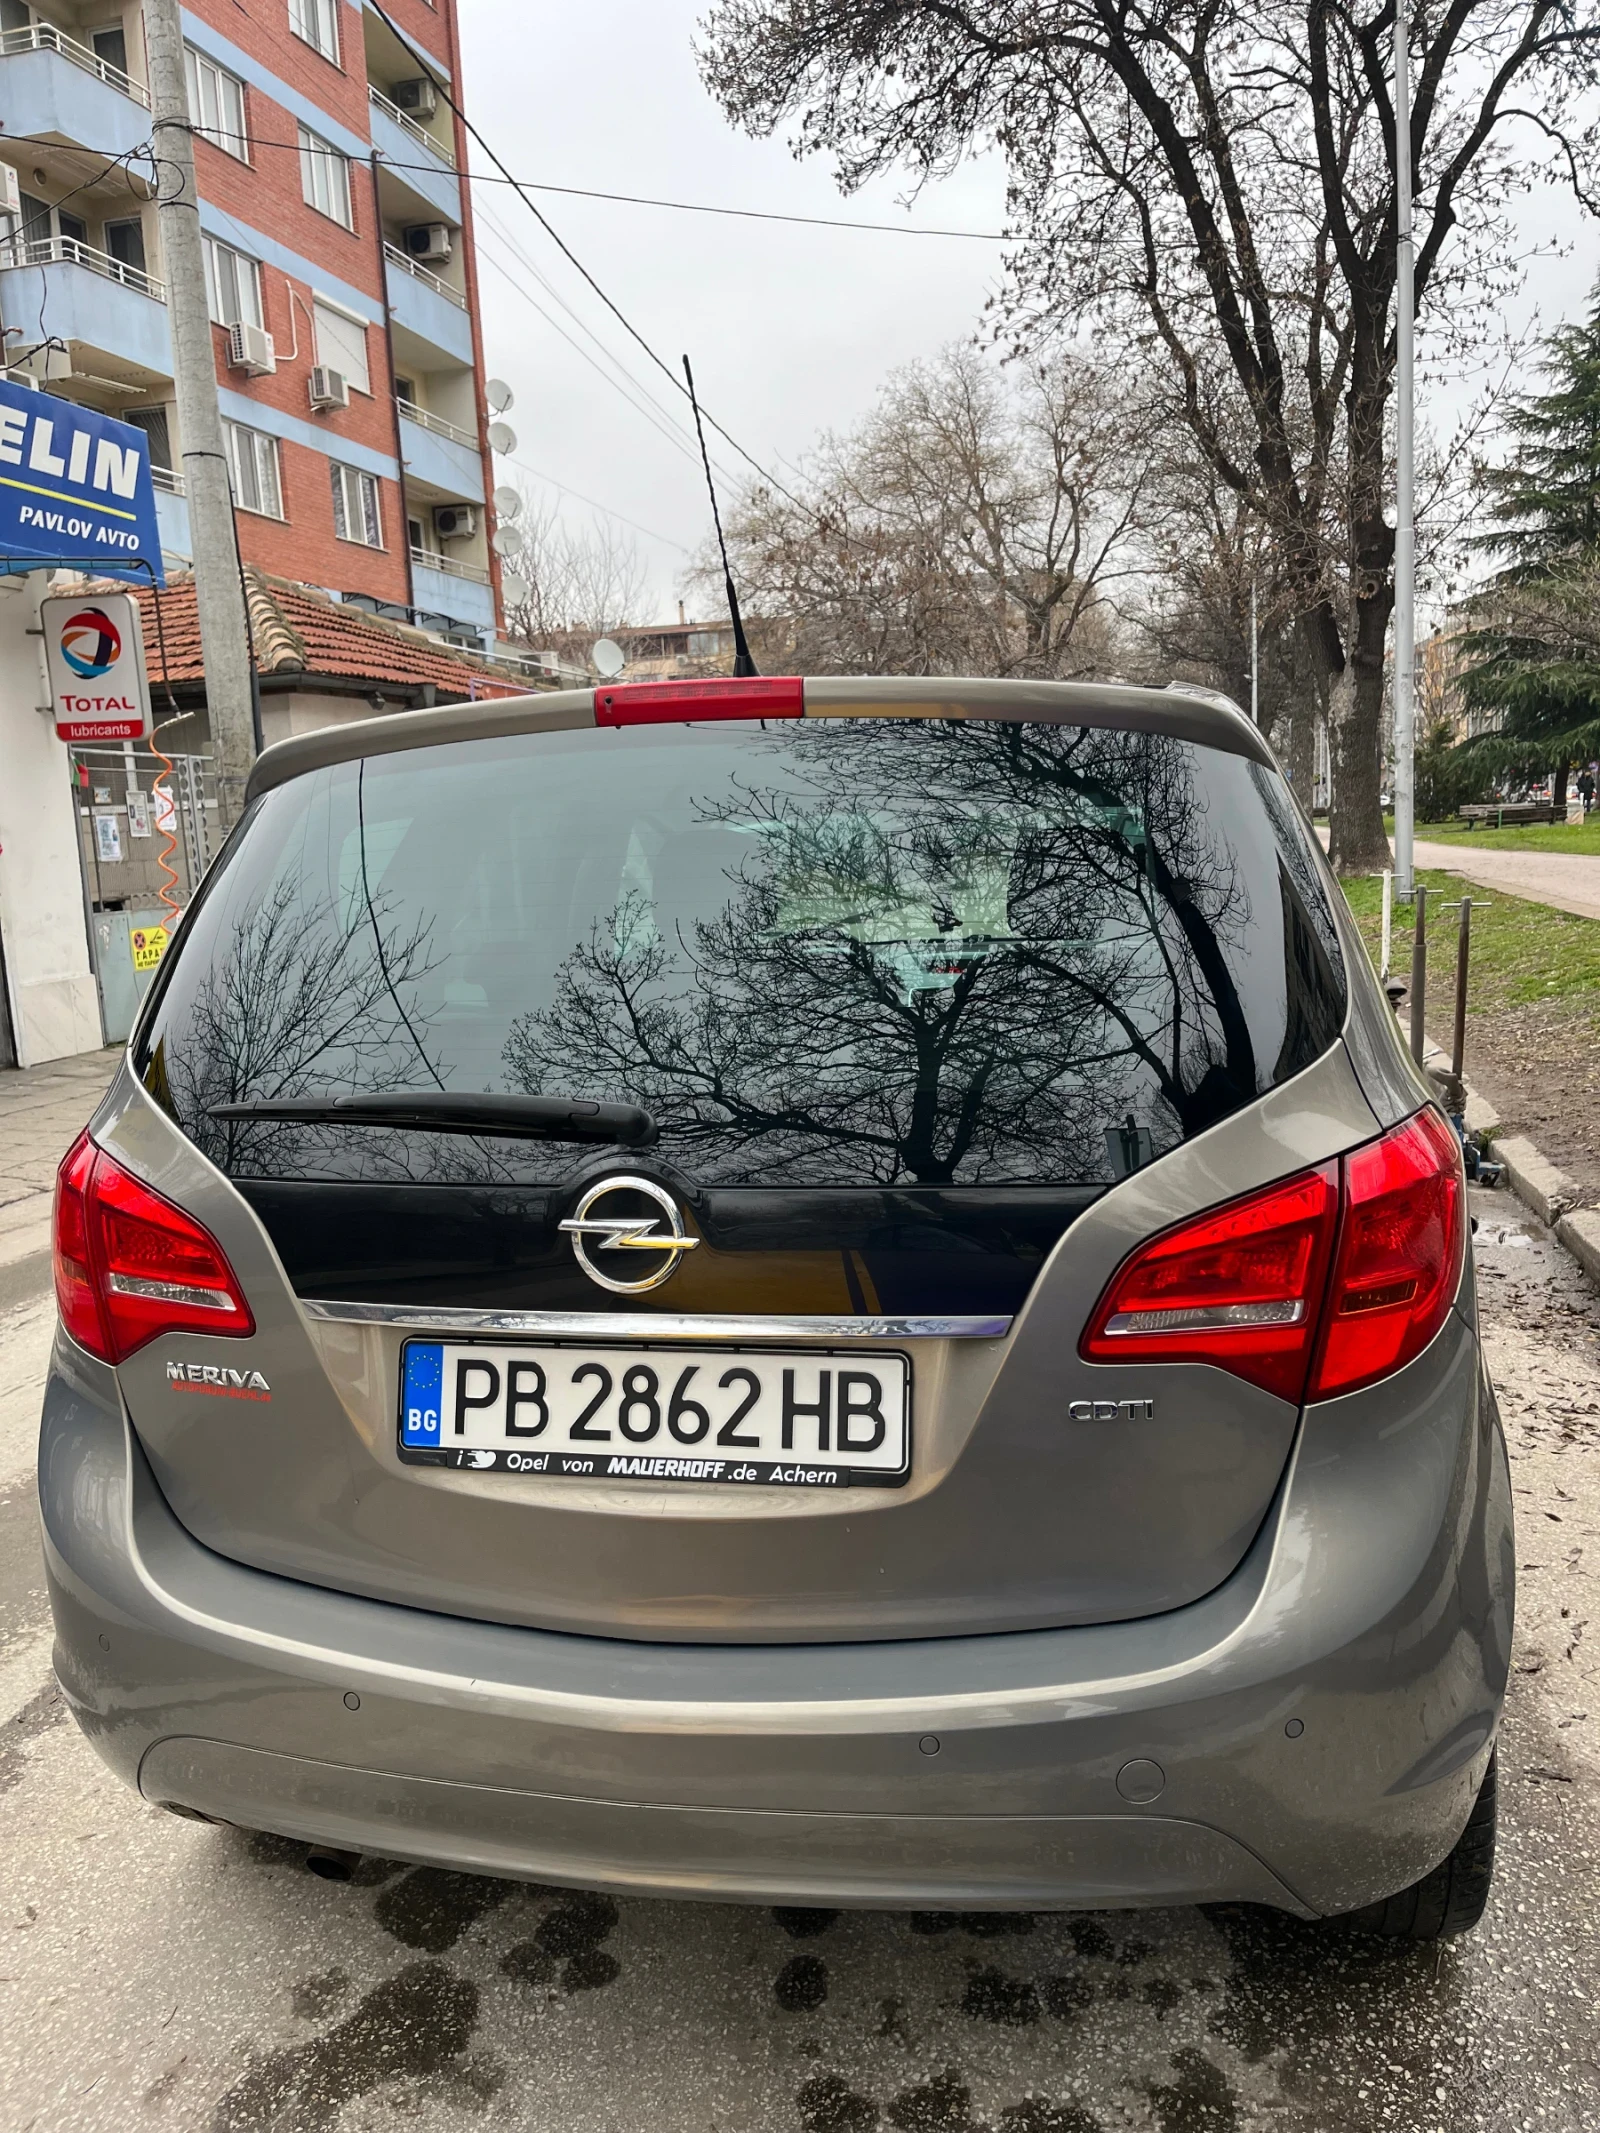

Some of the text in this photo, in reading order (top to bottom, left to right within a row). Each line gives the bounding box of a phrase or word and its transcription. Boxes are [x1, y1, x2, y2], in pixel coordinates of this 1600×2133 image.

[19, 505, 140, 551] PAVLOV AVTO
[70, 720, 131, 738] lubricants
[166, 1361, 271, 1391] MERIVA
[454, 1358, 887, 1453] PB 2862 HB
[1068, 1399, 1154, 1422] CDTI
[407, 1408, 437, 1434] BG
[506, 1452, 549, 1474] Opel
[562, 1457, 594, 1474] von
[768, 1465, 838, 1484] Achern
